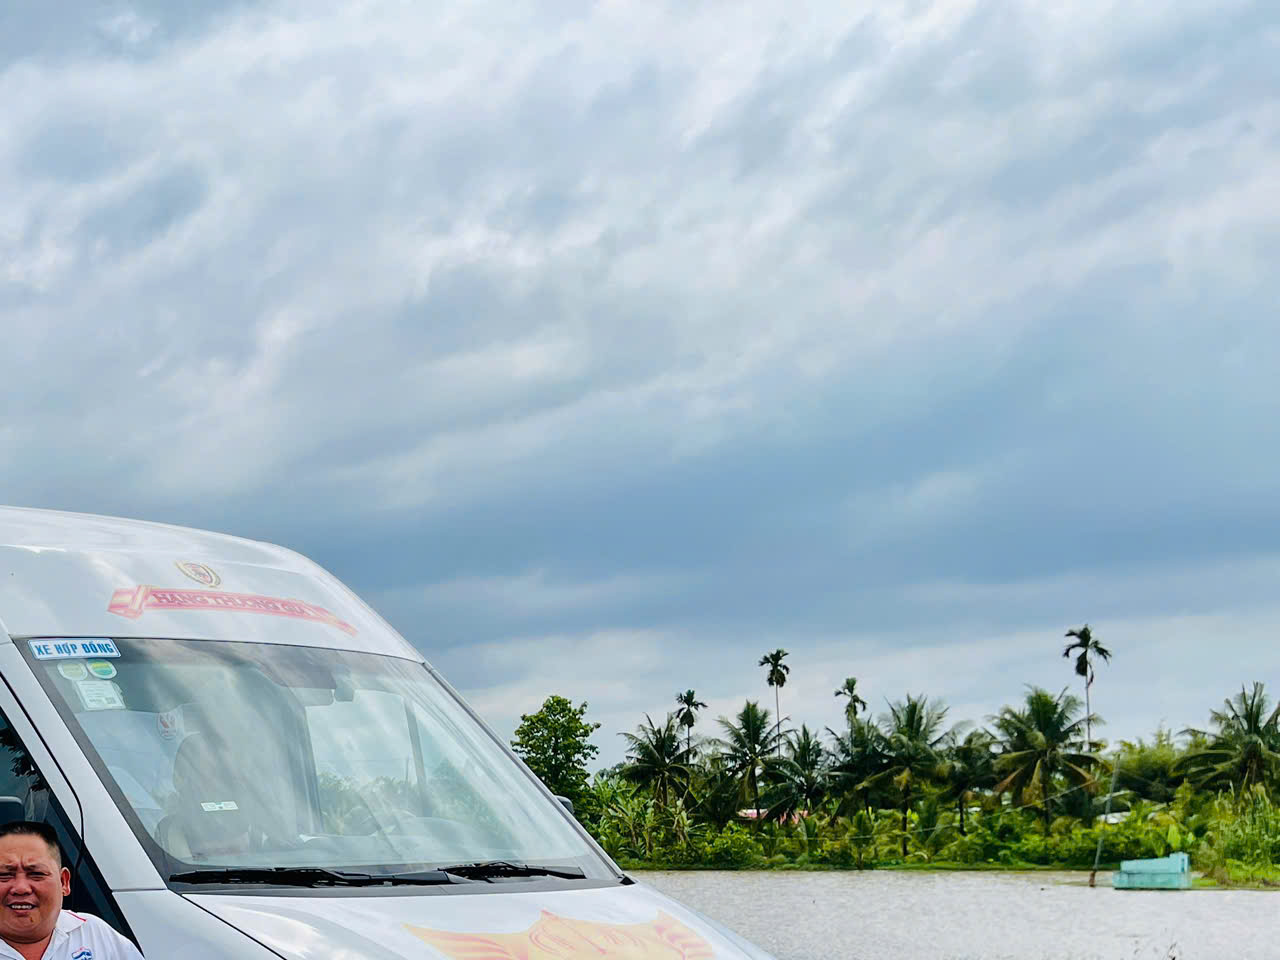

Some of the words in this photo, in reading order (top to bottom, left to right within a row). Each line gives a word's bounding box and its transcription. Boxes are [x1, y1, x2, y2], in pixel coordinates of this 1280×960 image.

[35, 643, 53, 655] XE
[54, 642, 78, 656] HỢP
[81, 641, 115, 654] ĐỒNG
